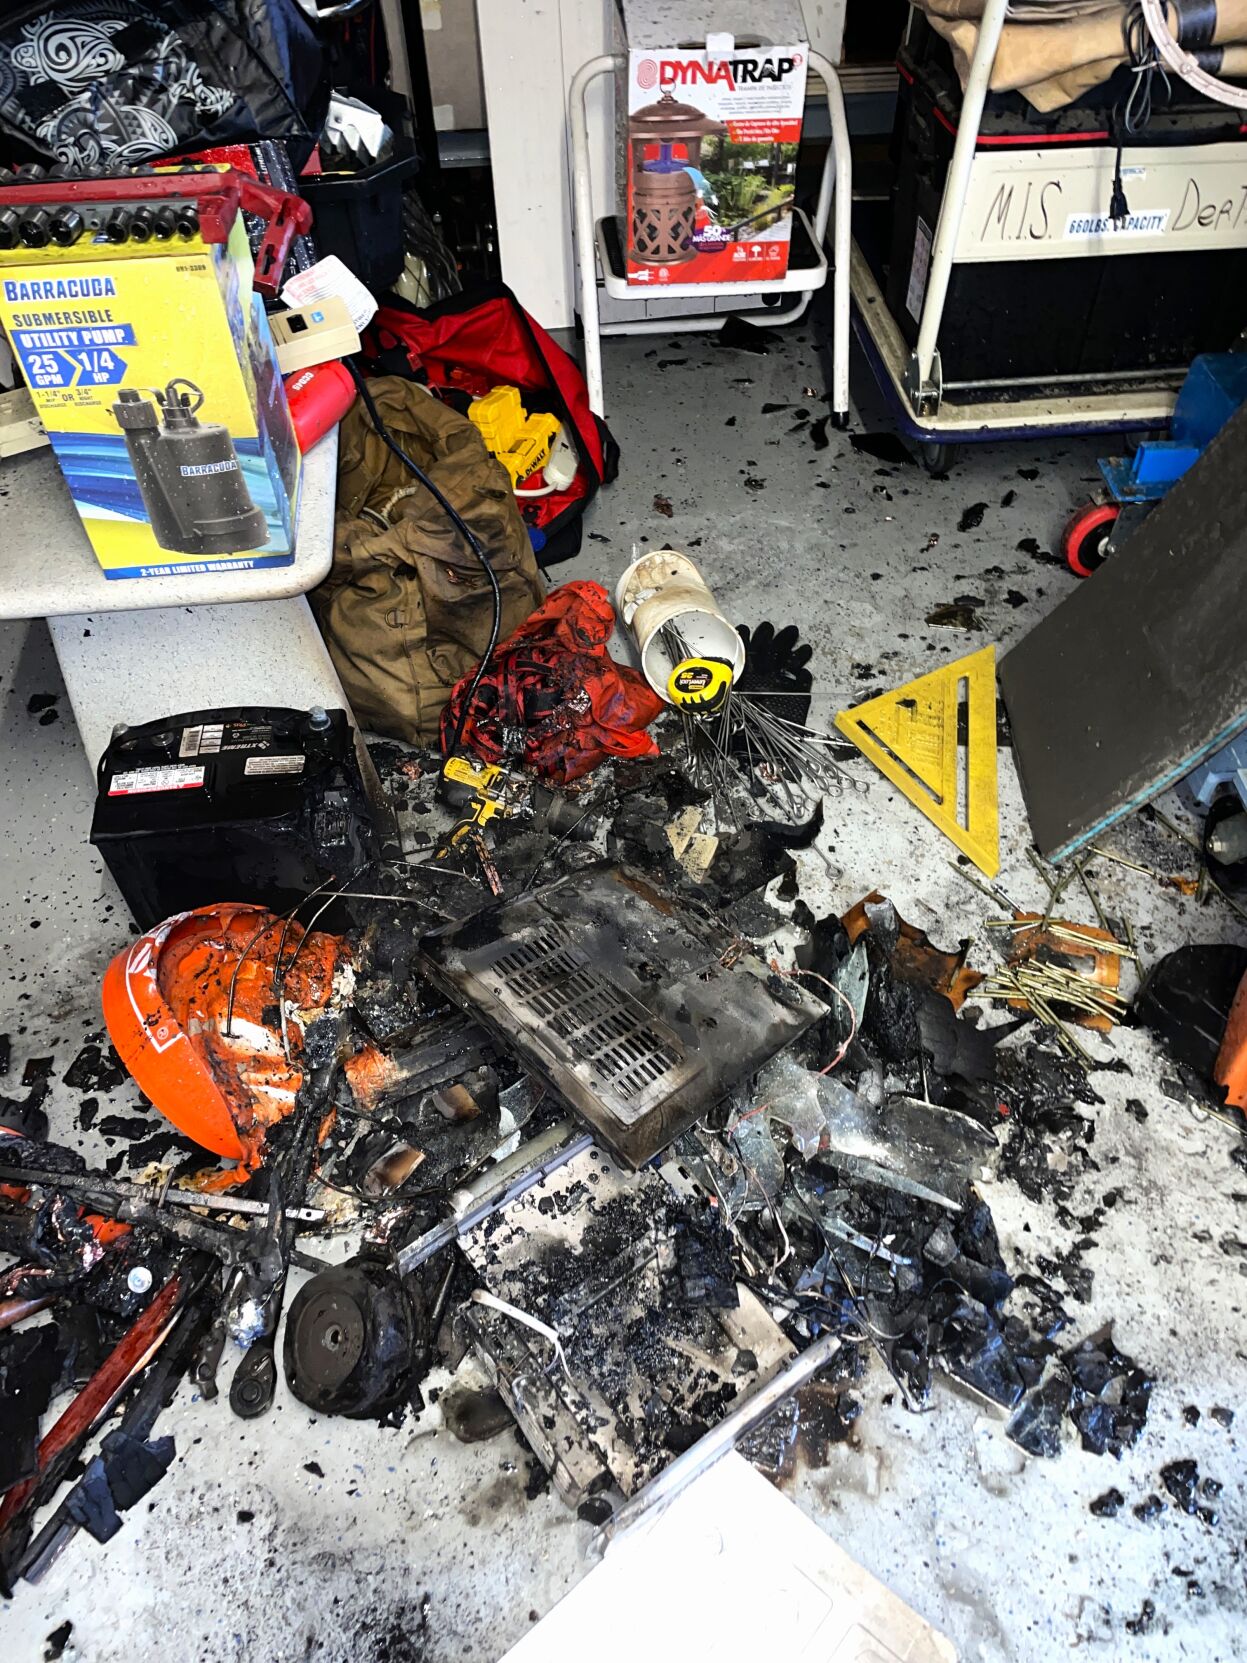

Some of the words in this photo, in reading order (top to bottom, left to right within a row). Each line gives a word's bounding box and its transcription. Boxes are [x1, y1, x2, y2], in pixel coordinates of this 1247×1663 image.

[660, 57, 795, 91] DYNATRAP
[4, 278, 115, 301] BARRACUDA
[12, 309, 114, 327] SUBMERSIBLE
[20, 331, 79, 349] UTILITY
[81, 329, 126, 345] PUMP
[27, 353, 59, 375] 25
[77, 350, 115, 373] 1/4
[35, 373, 65, 386] GPM
[92, 371, 111, 384] HP
[61, 393, 75, 402] OR
[180, 460, 238, 477] BARRACUDA
[140, 567, 171, 577] 2-YEAR
[172, 564, 206, 574] LIMITED
[206, 560, 254, 572] WARRANTY
